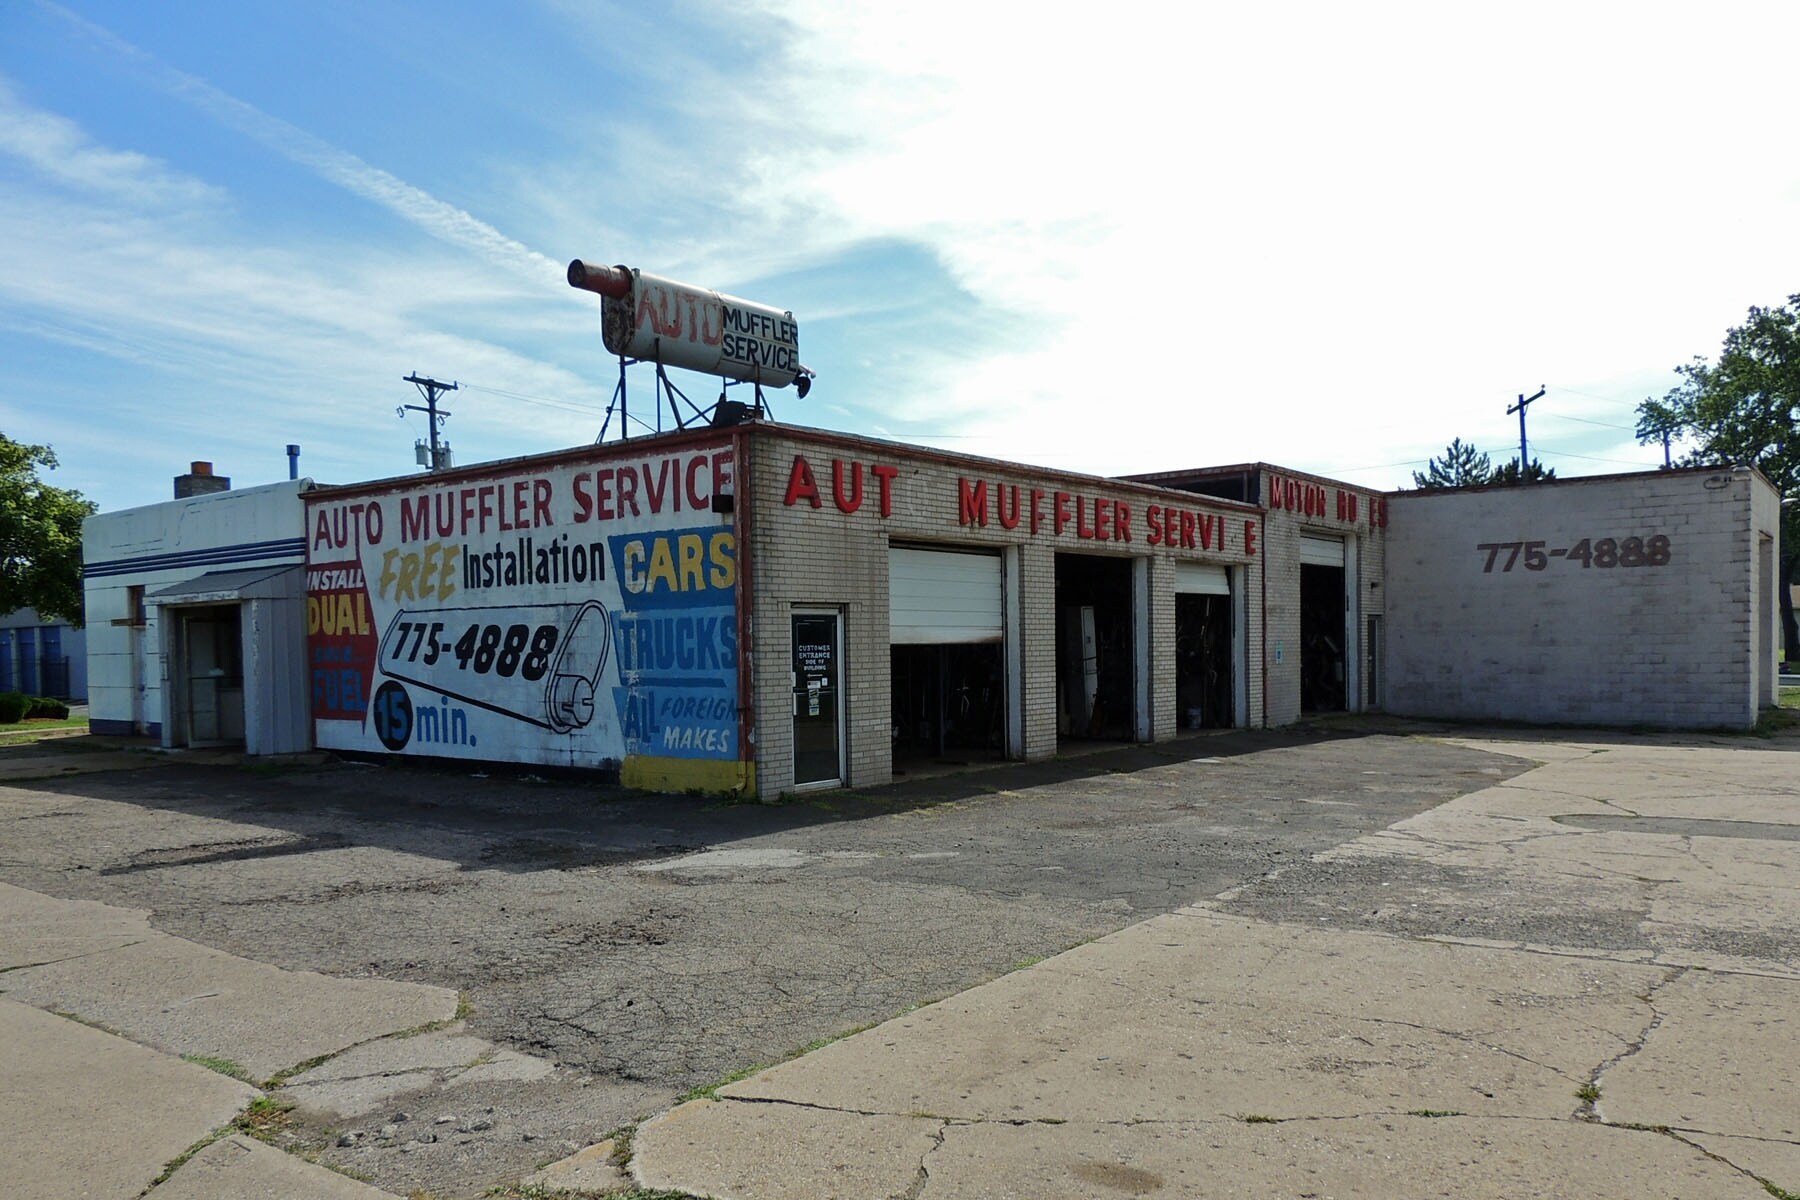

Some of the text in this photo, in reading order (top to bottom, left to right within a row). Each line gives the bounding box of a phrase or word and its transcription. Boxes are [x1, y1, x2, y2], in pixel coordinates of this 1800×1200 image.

[634, 286, 723, 346] AUTO
[723, 305, 799, 346] MUFFLER
[722, 333, 799, 373] SERVICE
[313, 451, 734, 552] AUTO MUFFLER SERVICE
[958, 477, 1132, 543] MUFFLER
[1269, 475, 1327, 518] MOTOR
[378, 533, 606, 602] FREE Installation
[623, 532, 736, 595] CARS
[1476, 534, 1672, 574] 775-4888
[306, 568, 365, 591] INSTALL
[307, 592, 370, 637] DUAL
[391, 622, 559, 681] 775-4888
[618, 615, 737, 671] TRUCKS
[798, 644, 831, 652] CUSTOMER
[313, 668, 368, 712] FUEL
[376, 688, 477, 747] 15 min.
[624, 690, 660, 744] ALL
[663, 726, 731, 753] MAKES
